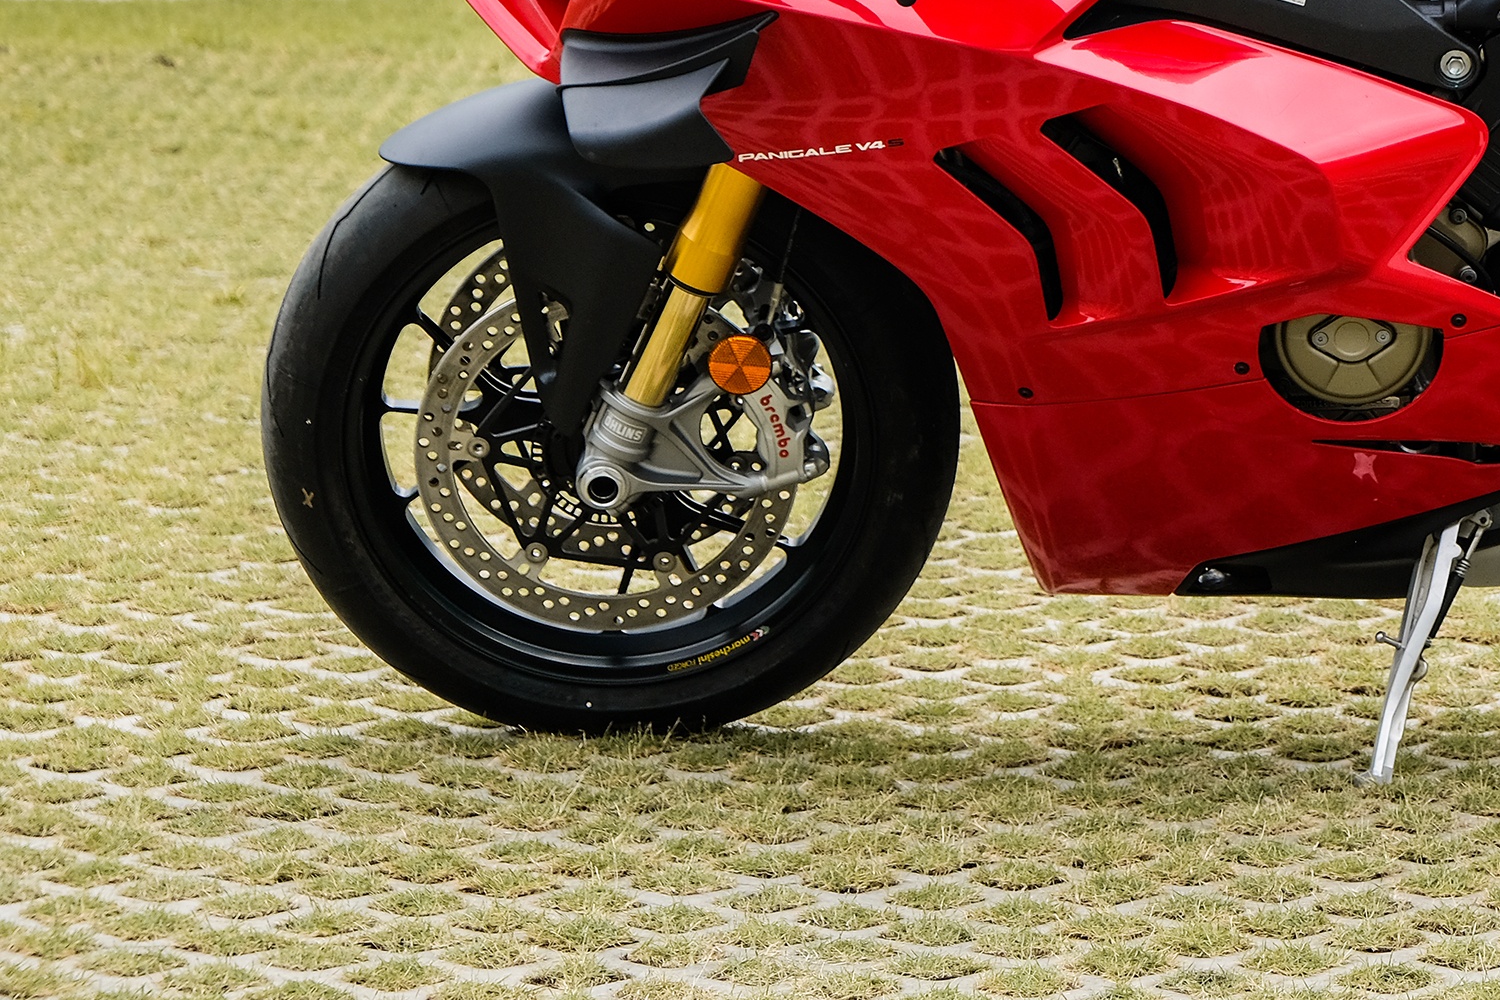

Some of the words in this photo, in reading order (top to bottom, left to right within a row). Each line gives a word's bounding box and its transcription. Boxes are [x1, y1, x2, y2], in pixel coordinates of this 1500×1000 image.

[738, 144, 853, 163] PANIGALE
[855, 140, 886, 151] V4
[760, 394, 791, 458] brembo
[697, 635, 751, 665] marchesini
